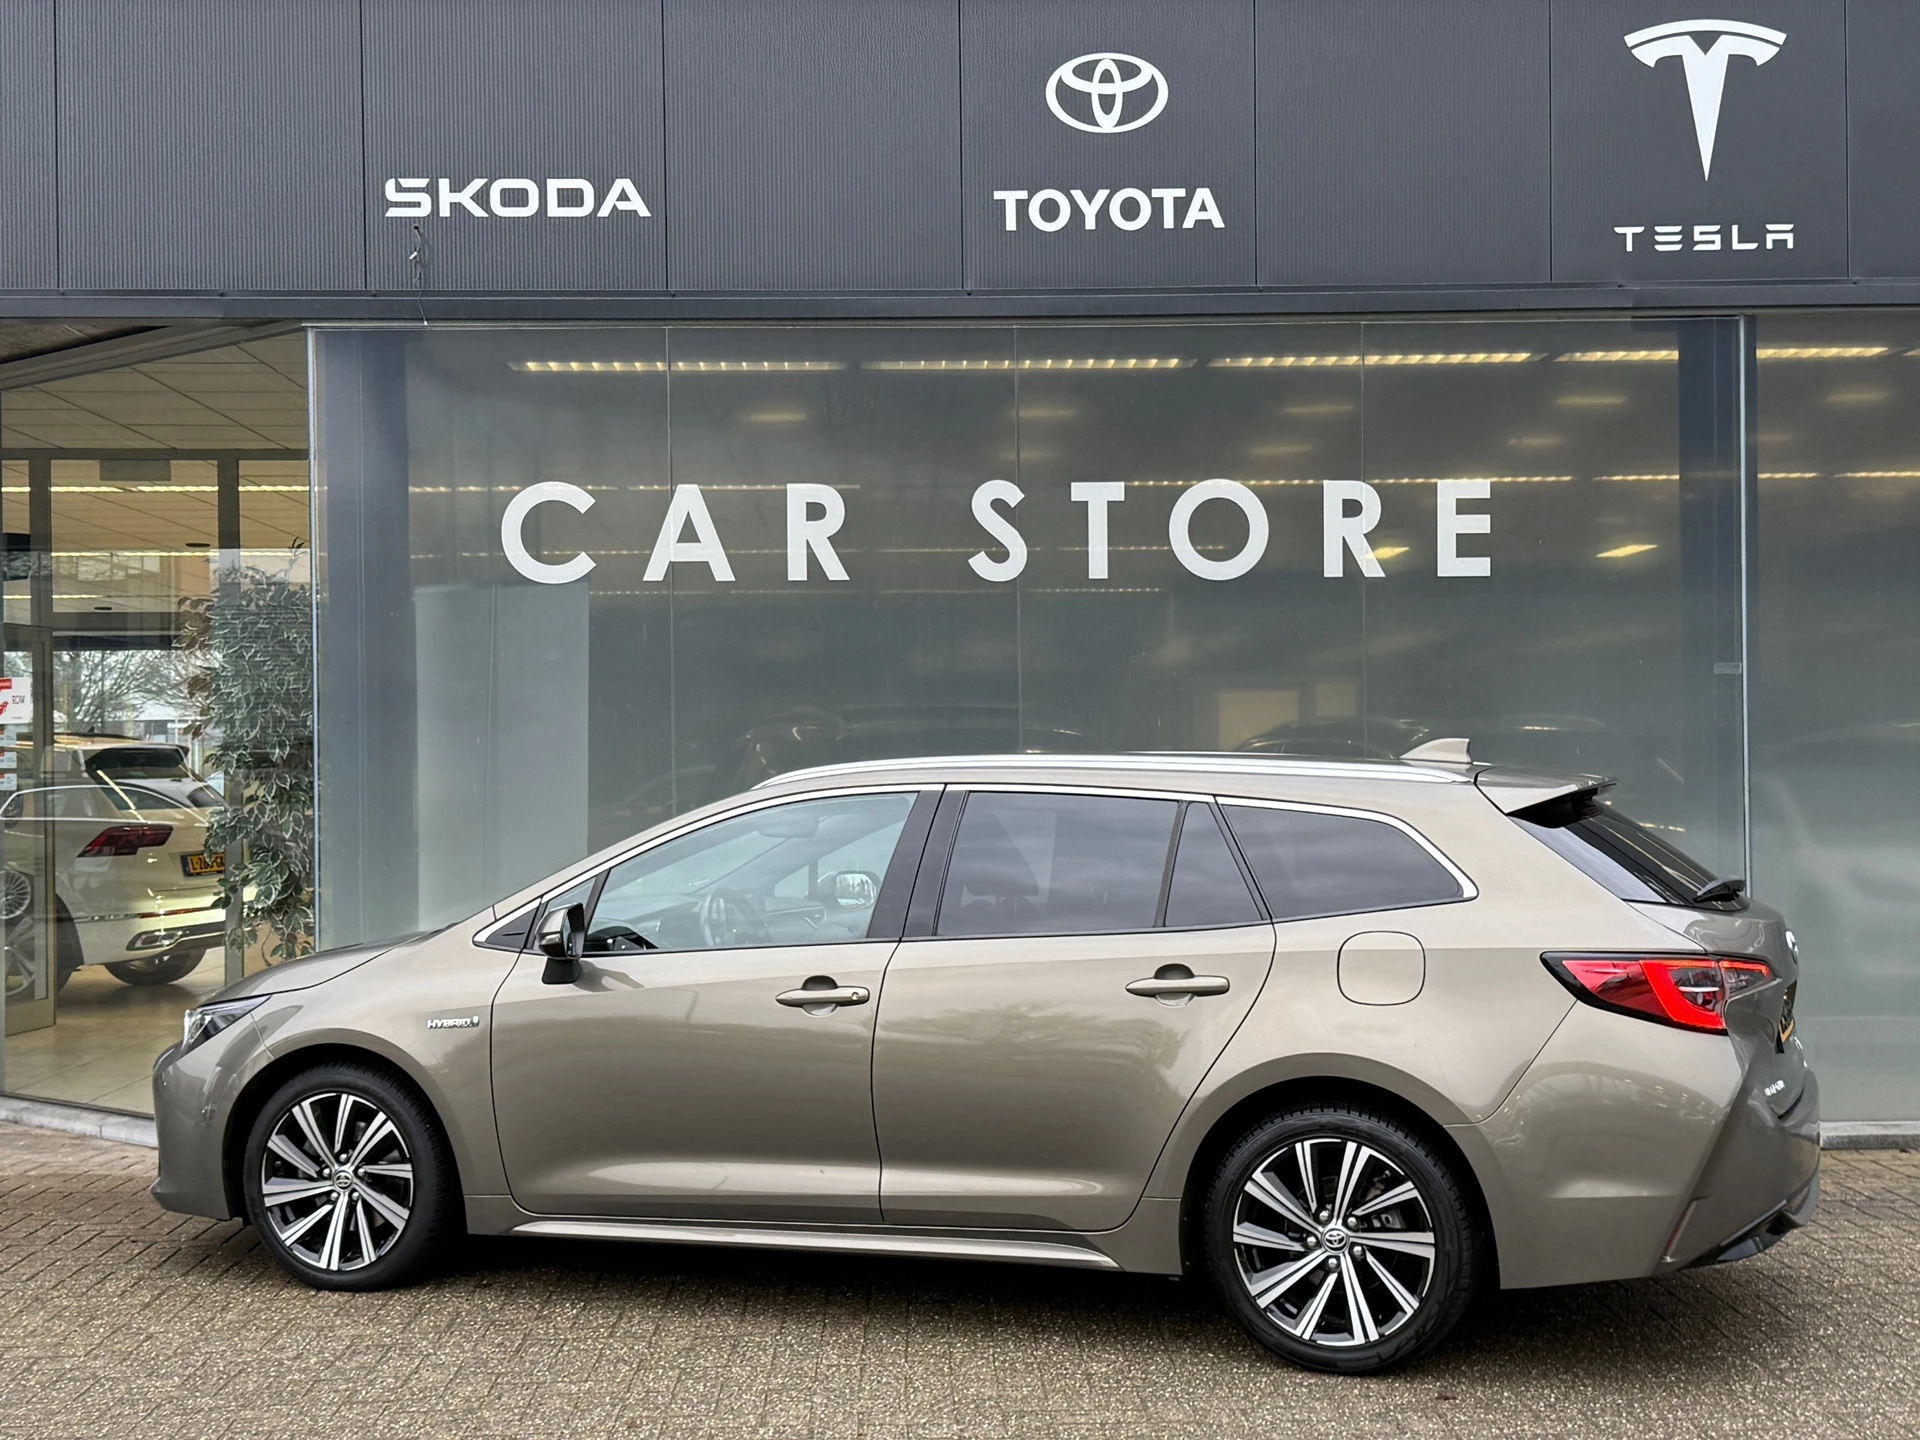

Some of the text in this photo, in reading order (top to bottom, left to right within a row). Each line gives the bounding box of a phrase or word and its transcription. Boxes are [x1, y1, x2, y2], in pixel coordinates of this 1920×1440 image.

[993, 187, 1226, 232] TOYOTA
[1613, 223, 1795, 252] TESLA
[500, 478, 1492, 584] CAR STORE
[427, 1018, 471, 1029] HYBRID
